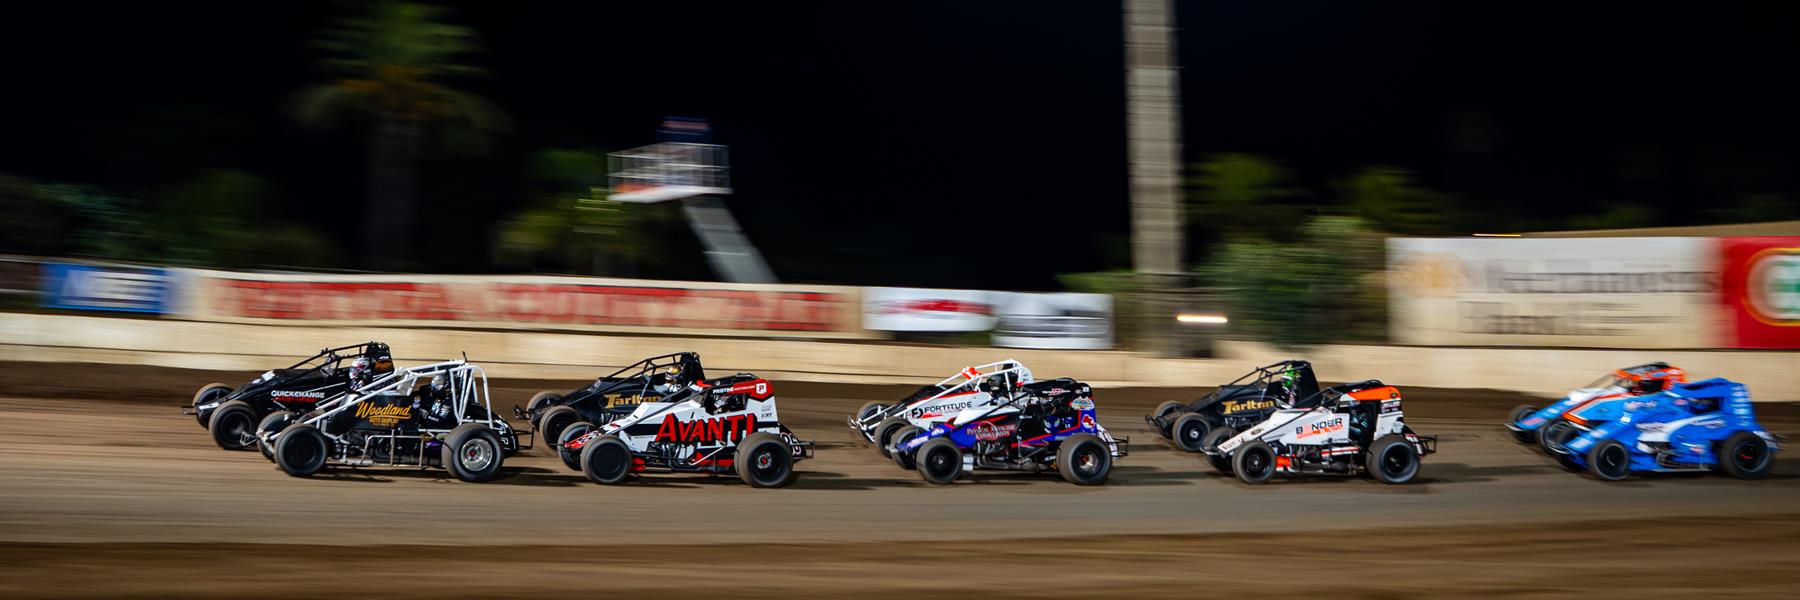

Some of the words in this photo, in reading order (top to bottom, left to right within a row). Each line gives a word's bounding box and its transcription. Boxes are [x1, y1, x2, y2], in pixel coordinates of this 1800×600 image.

[271, 390, 325, 399] QUICKCHANGE
[355, 400, 412, 419] Woodland
[924, 401, 972, 413] FORTITUDE
[1222, 400, 1275, 414] Tarlton
[655, 412, 757, 443] AVANTI
